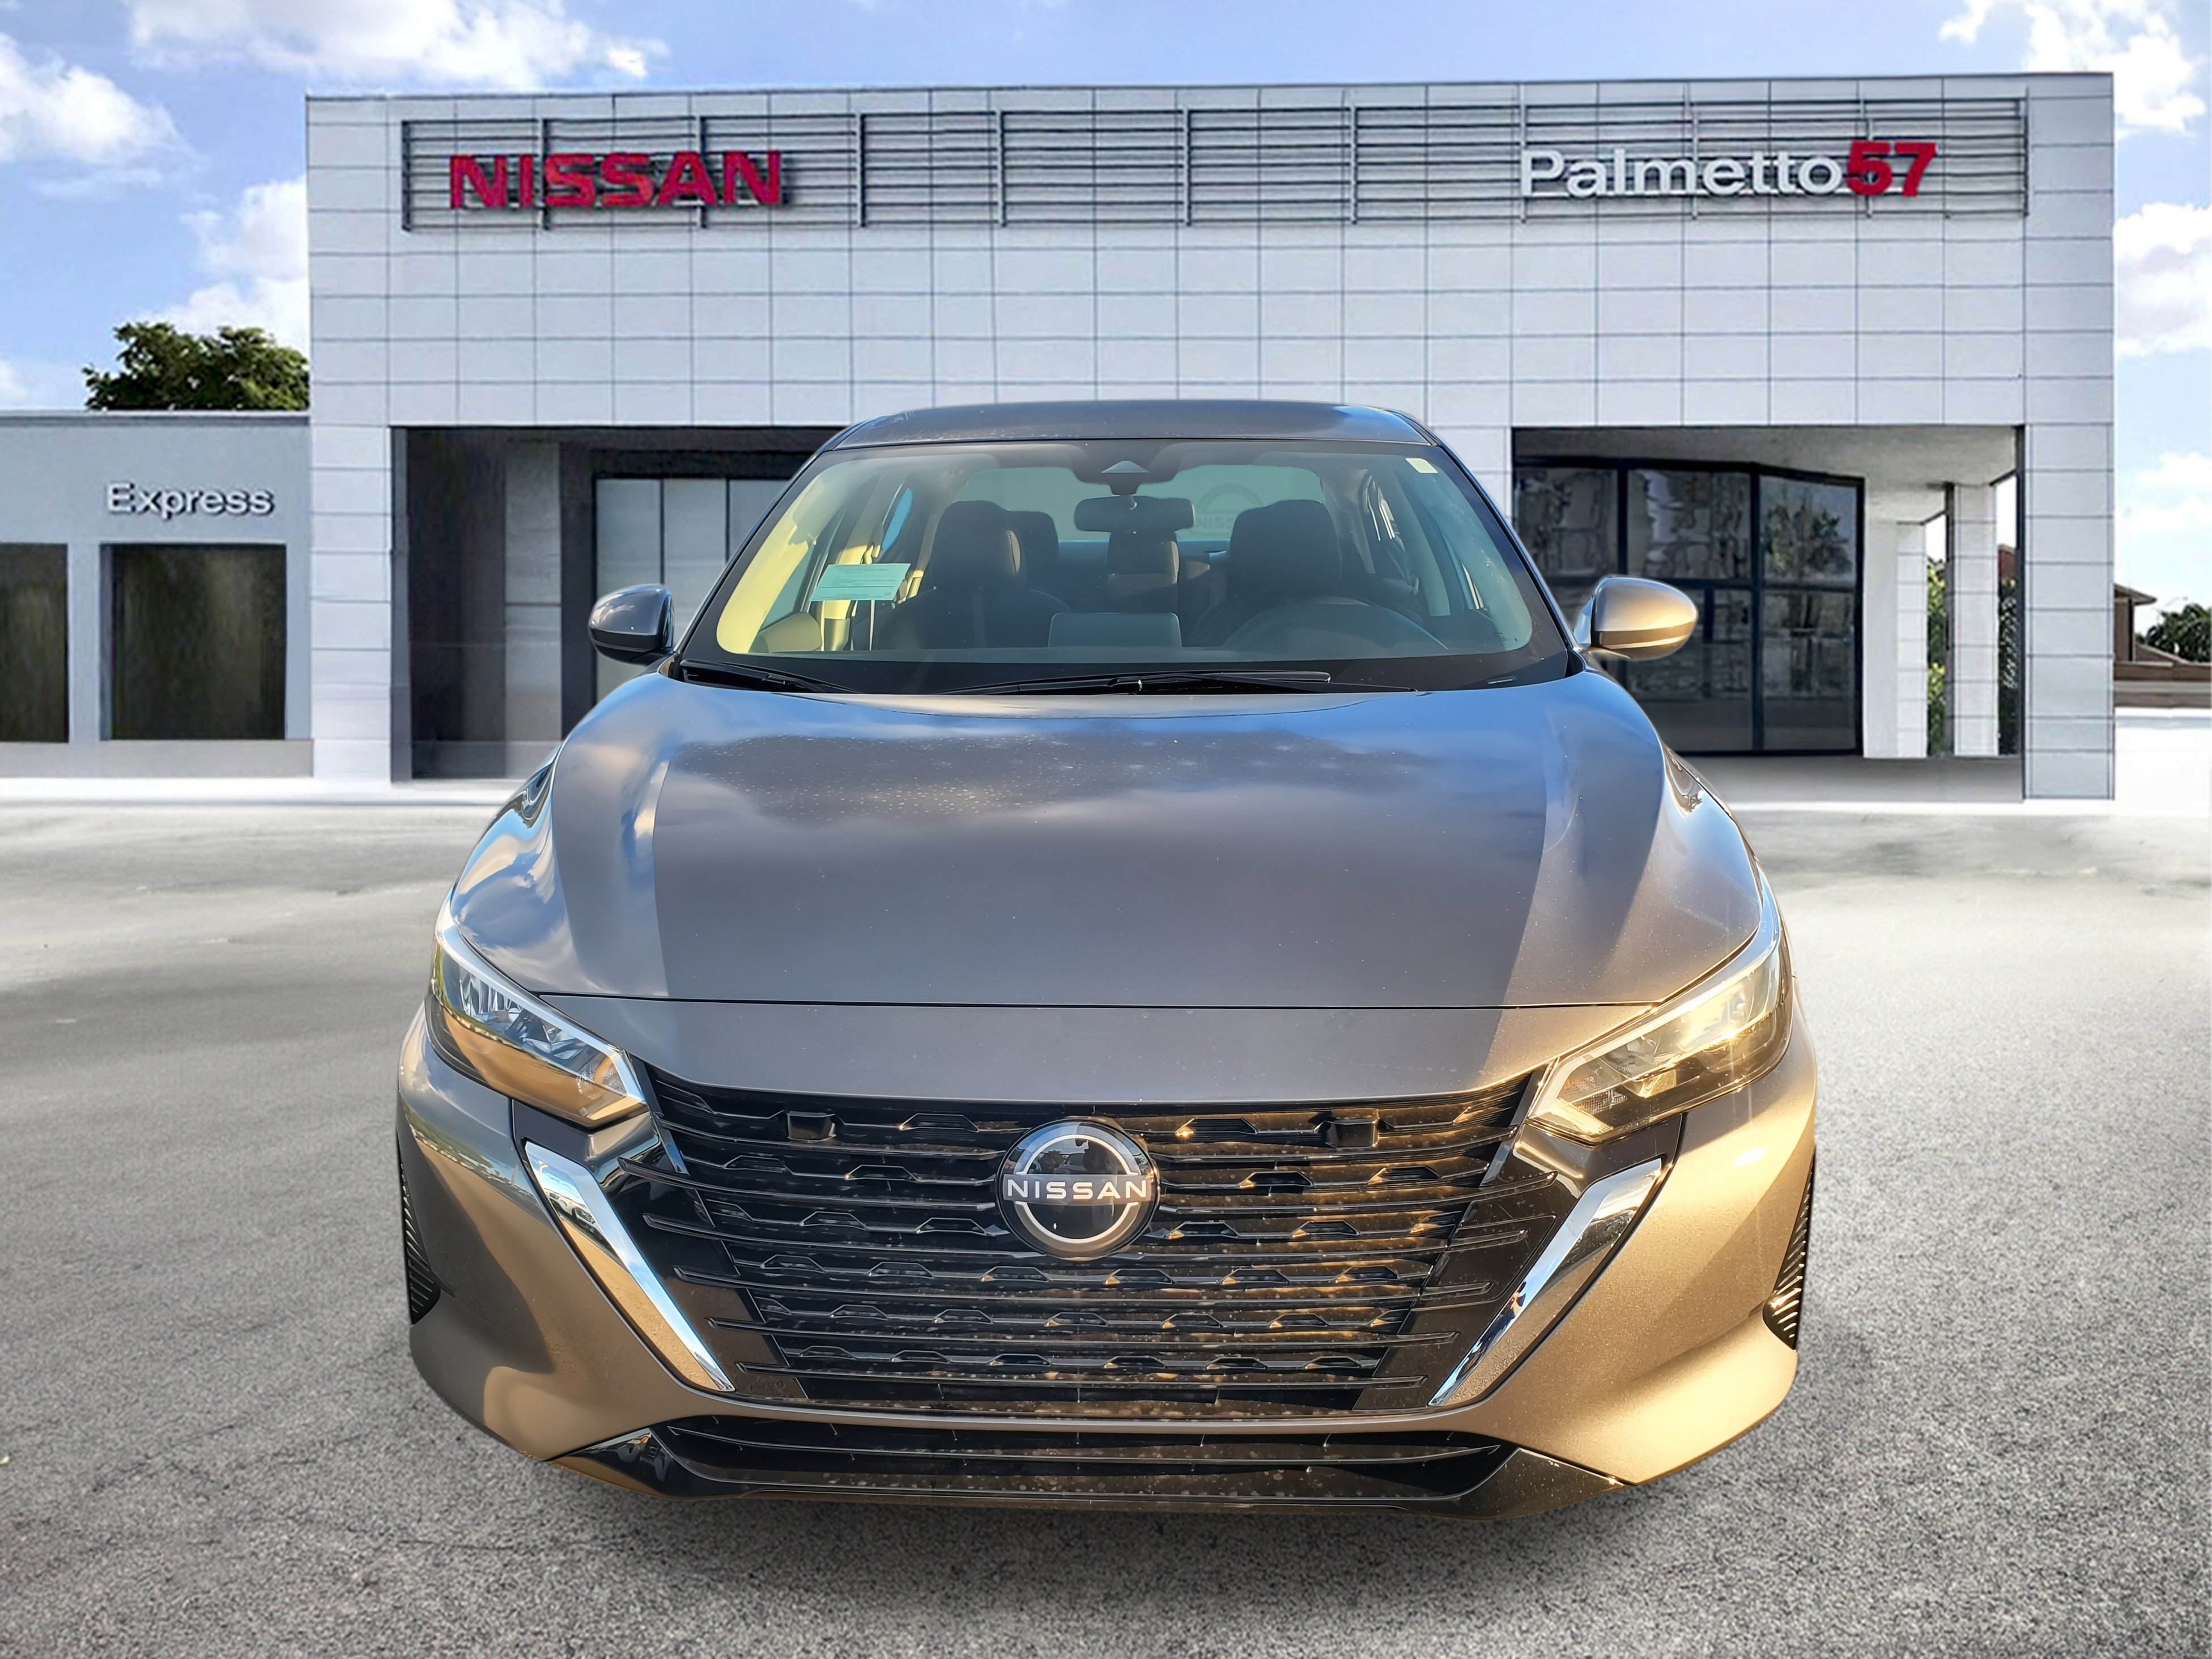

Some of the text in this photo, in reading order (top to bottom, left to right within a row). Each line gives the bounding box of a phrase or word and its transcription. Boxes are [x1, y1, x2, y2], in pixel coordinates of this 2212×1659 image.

[450, 150, 781, 209] NISSAN
[1520, 141, 1936, 198] Palmetto57
[108, 482, 275, 520] Express
[1007, 1179, 1147, 1199] NISSAN
